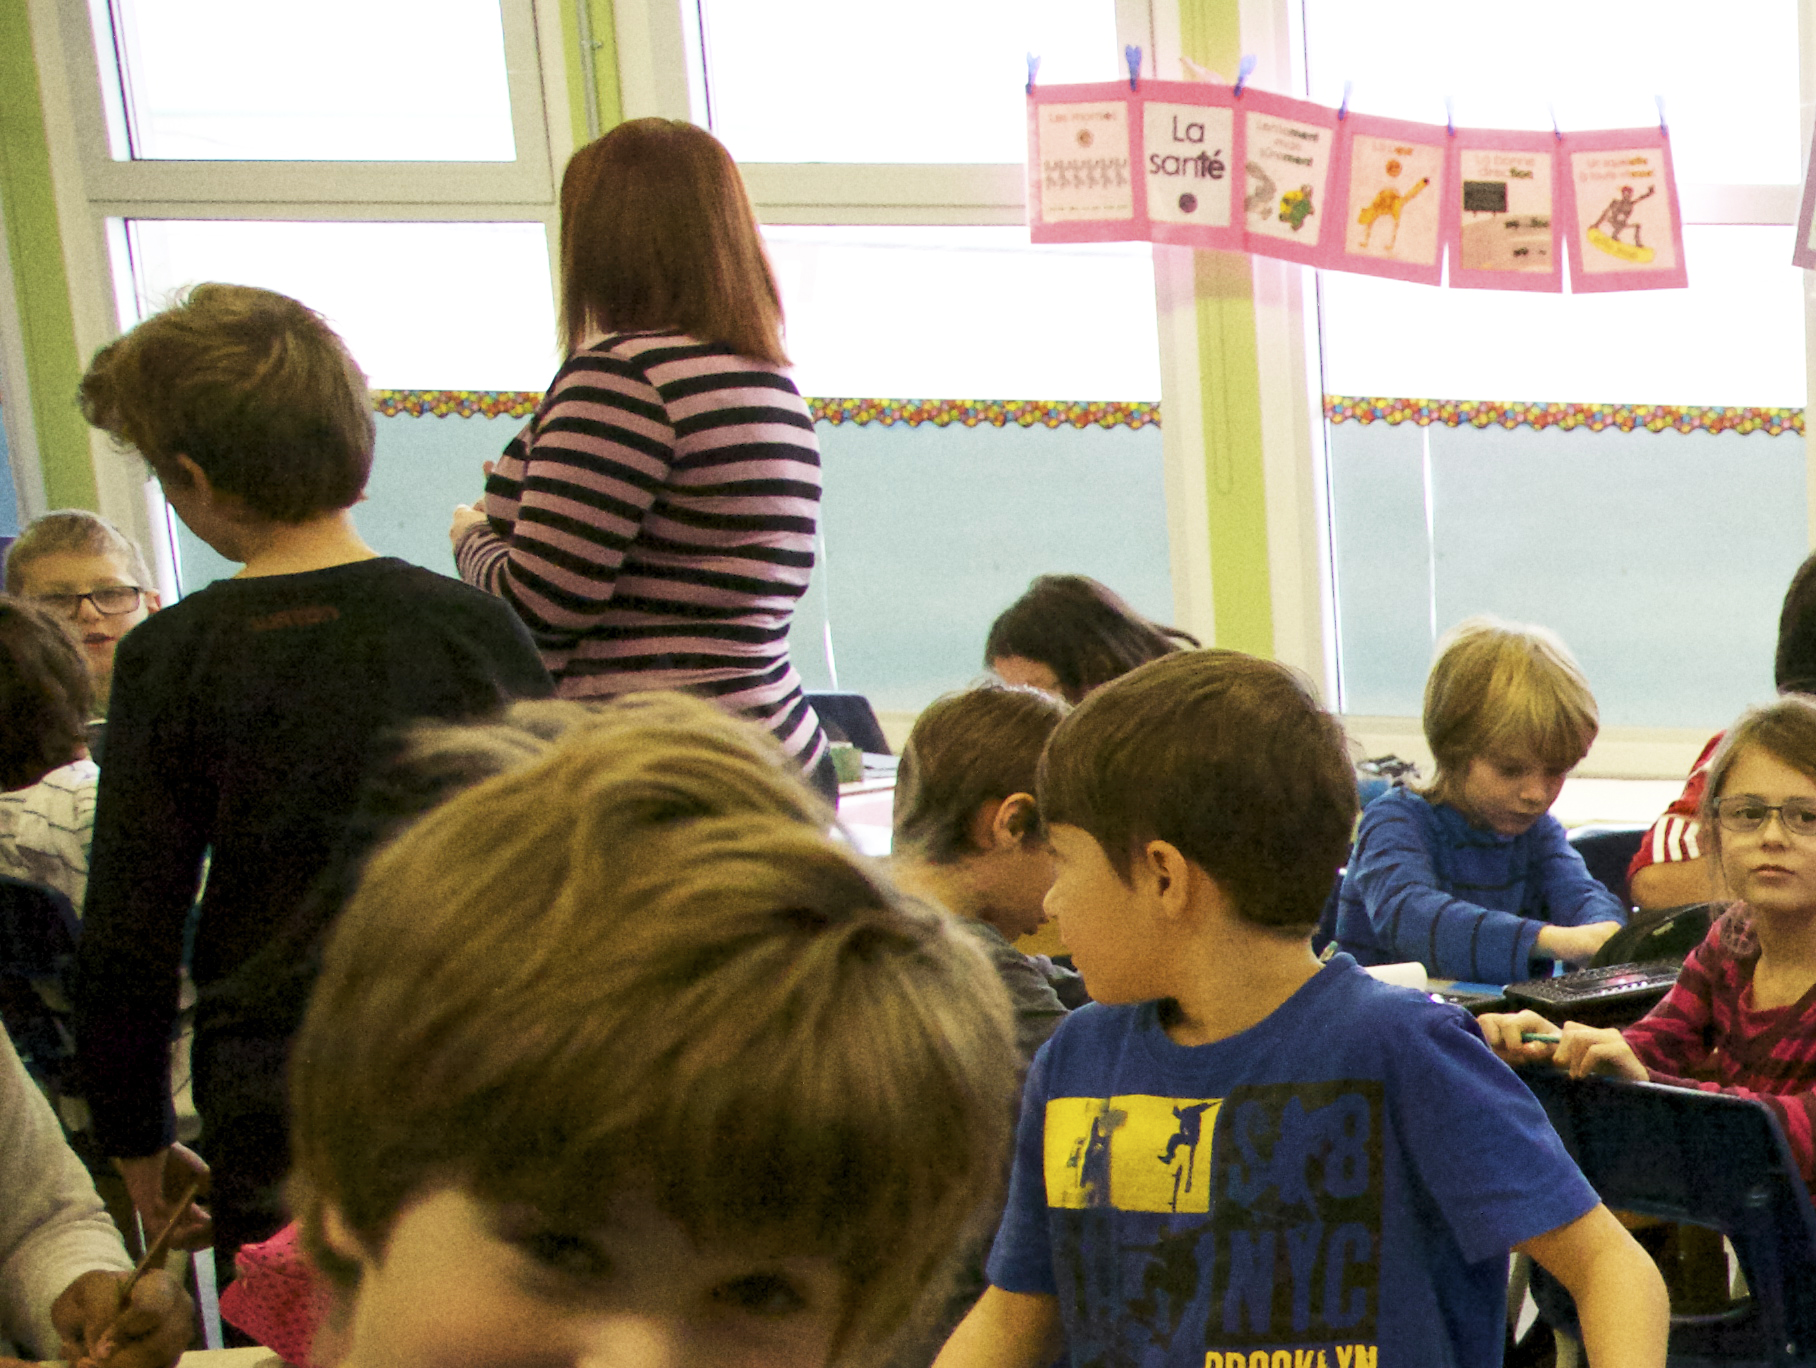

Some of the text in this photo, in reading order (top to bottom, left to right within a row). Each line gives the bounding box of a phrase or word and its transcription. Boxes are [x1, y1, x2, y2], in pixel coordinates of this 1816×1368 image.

[1173, 115, 1205, 143] La
[1150, 149, 1226, 180] santé
[1222, 1222, 1374, 1334] NYC
